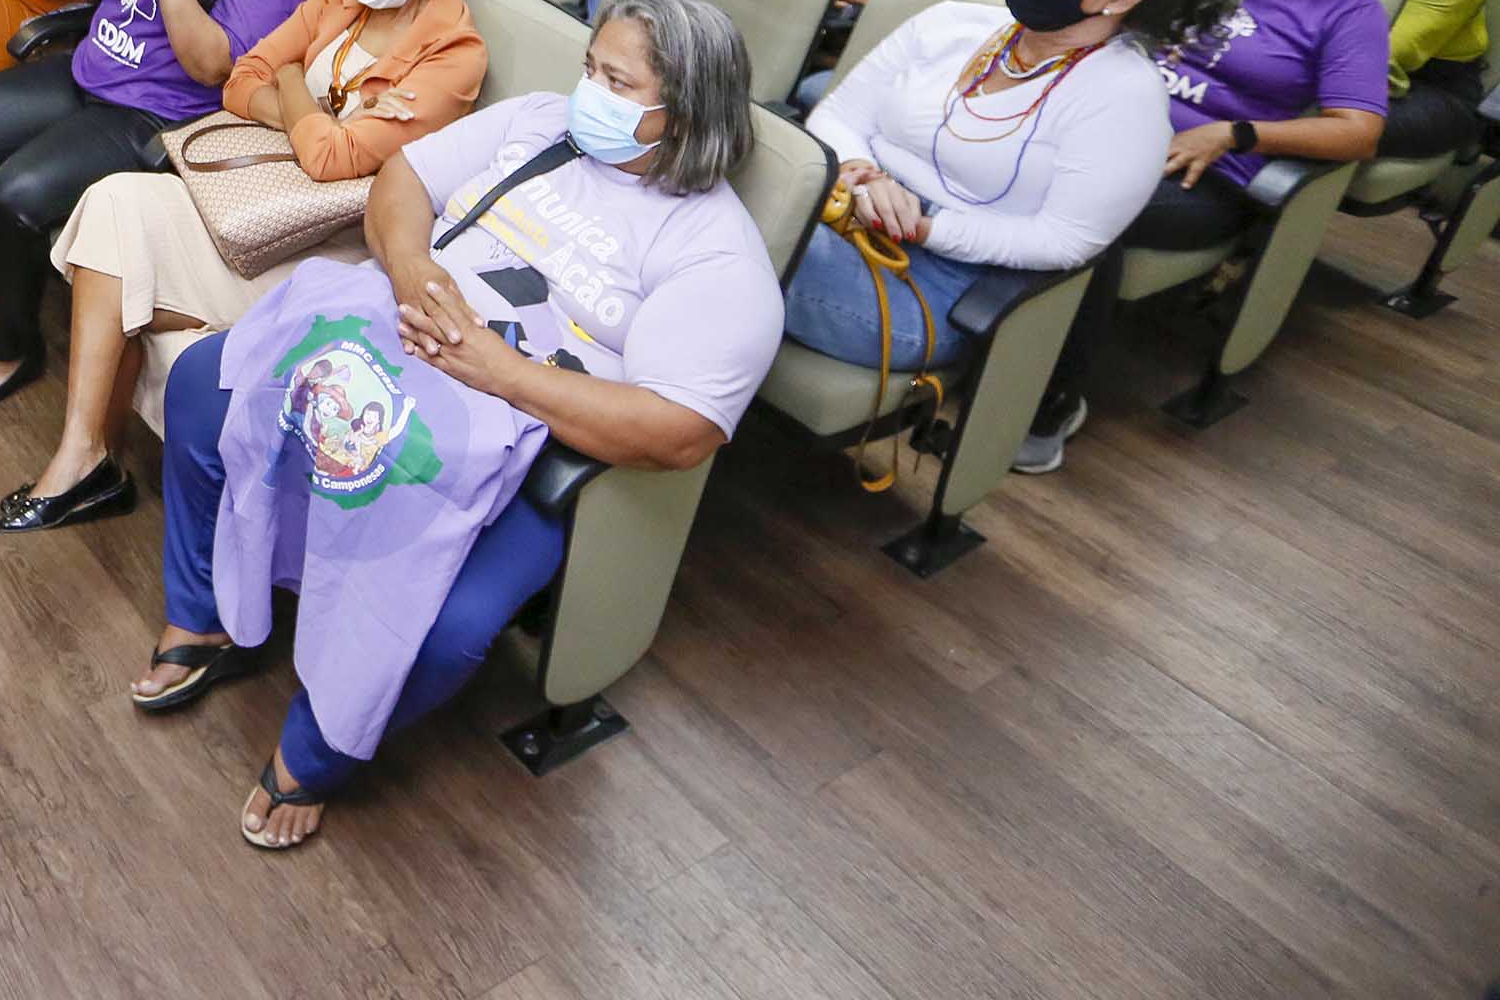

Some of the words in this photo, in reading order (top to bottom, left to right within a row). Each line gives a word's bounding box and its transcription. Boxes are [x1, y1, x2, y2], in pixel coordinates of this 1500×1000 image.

[98, 18, 145, 63] CDDM
[340, 341, 373, 362] MMC
[321, 463, 385, 492] Camponesas
